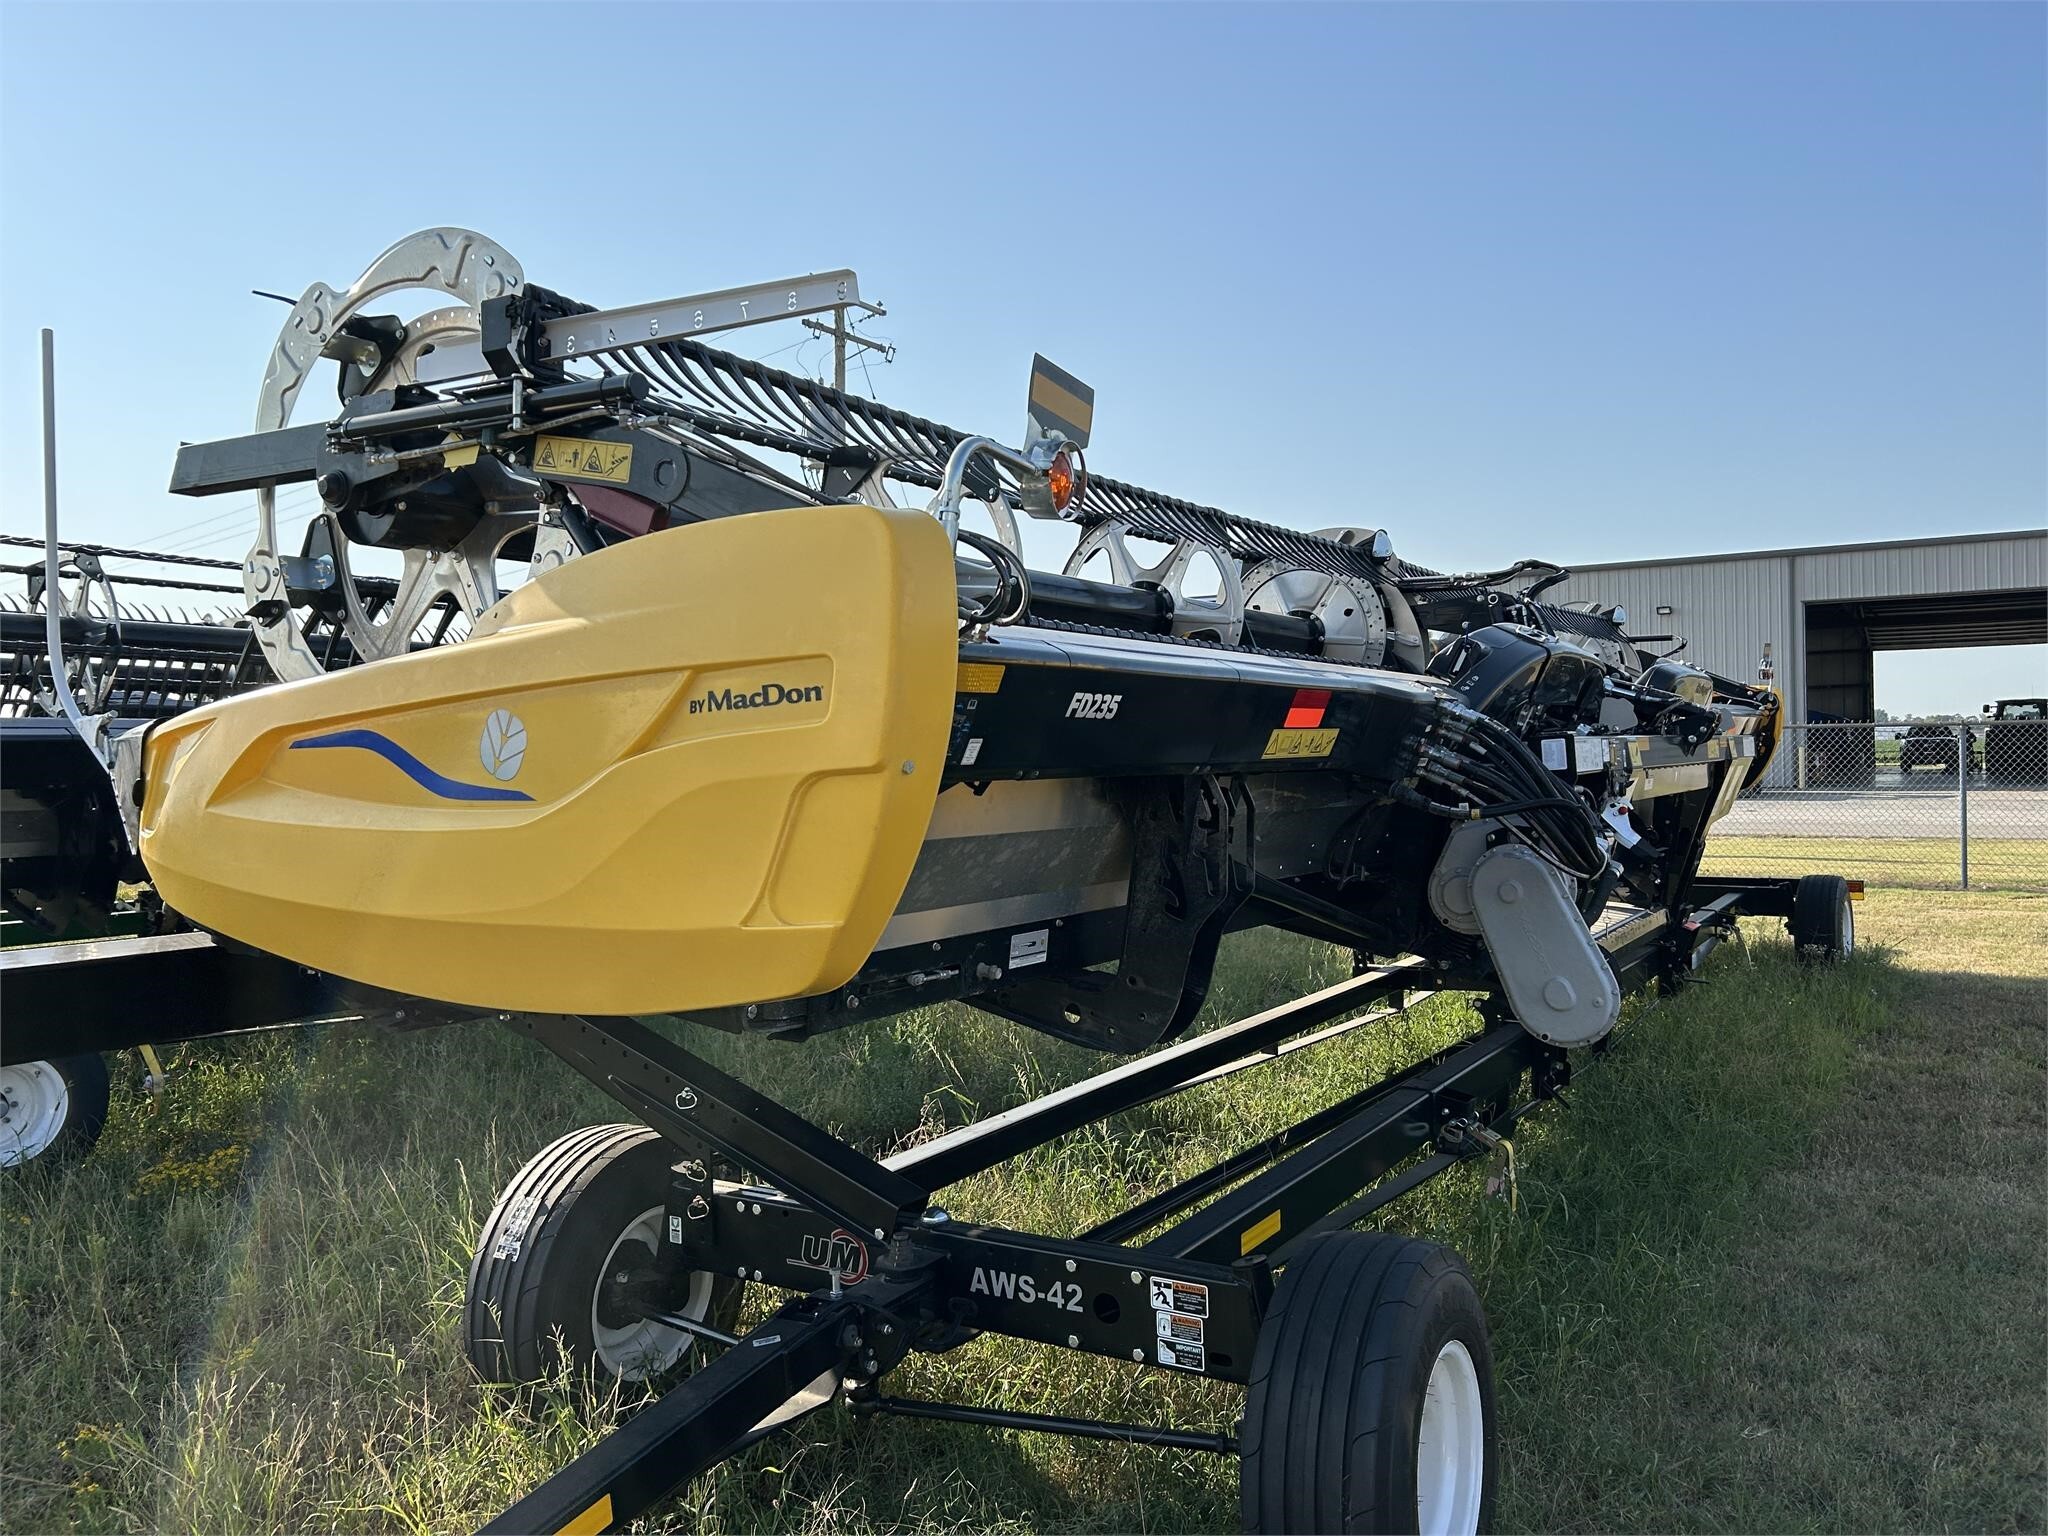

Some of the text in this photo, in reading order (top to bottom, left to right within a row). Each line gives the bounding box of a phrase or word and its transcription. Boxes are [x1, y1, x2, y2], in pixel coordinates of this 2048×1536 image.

[689, 683, 823, 714] BY MacDon
[1065, 692, 1123, 720] FD235
[970, 1266, 1084, 1313] AWS-42
